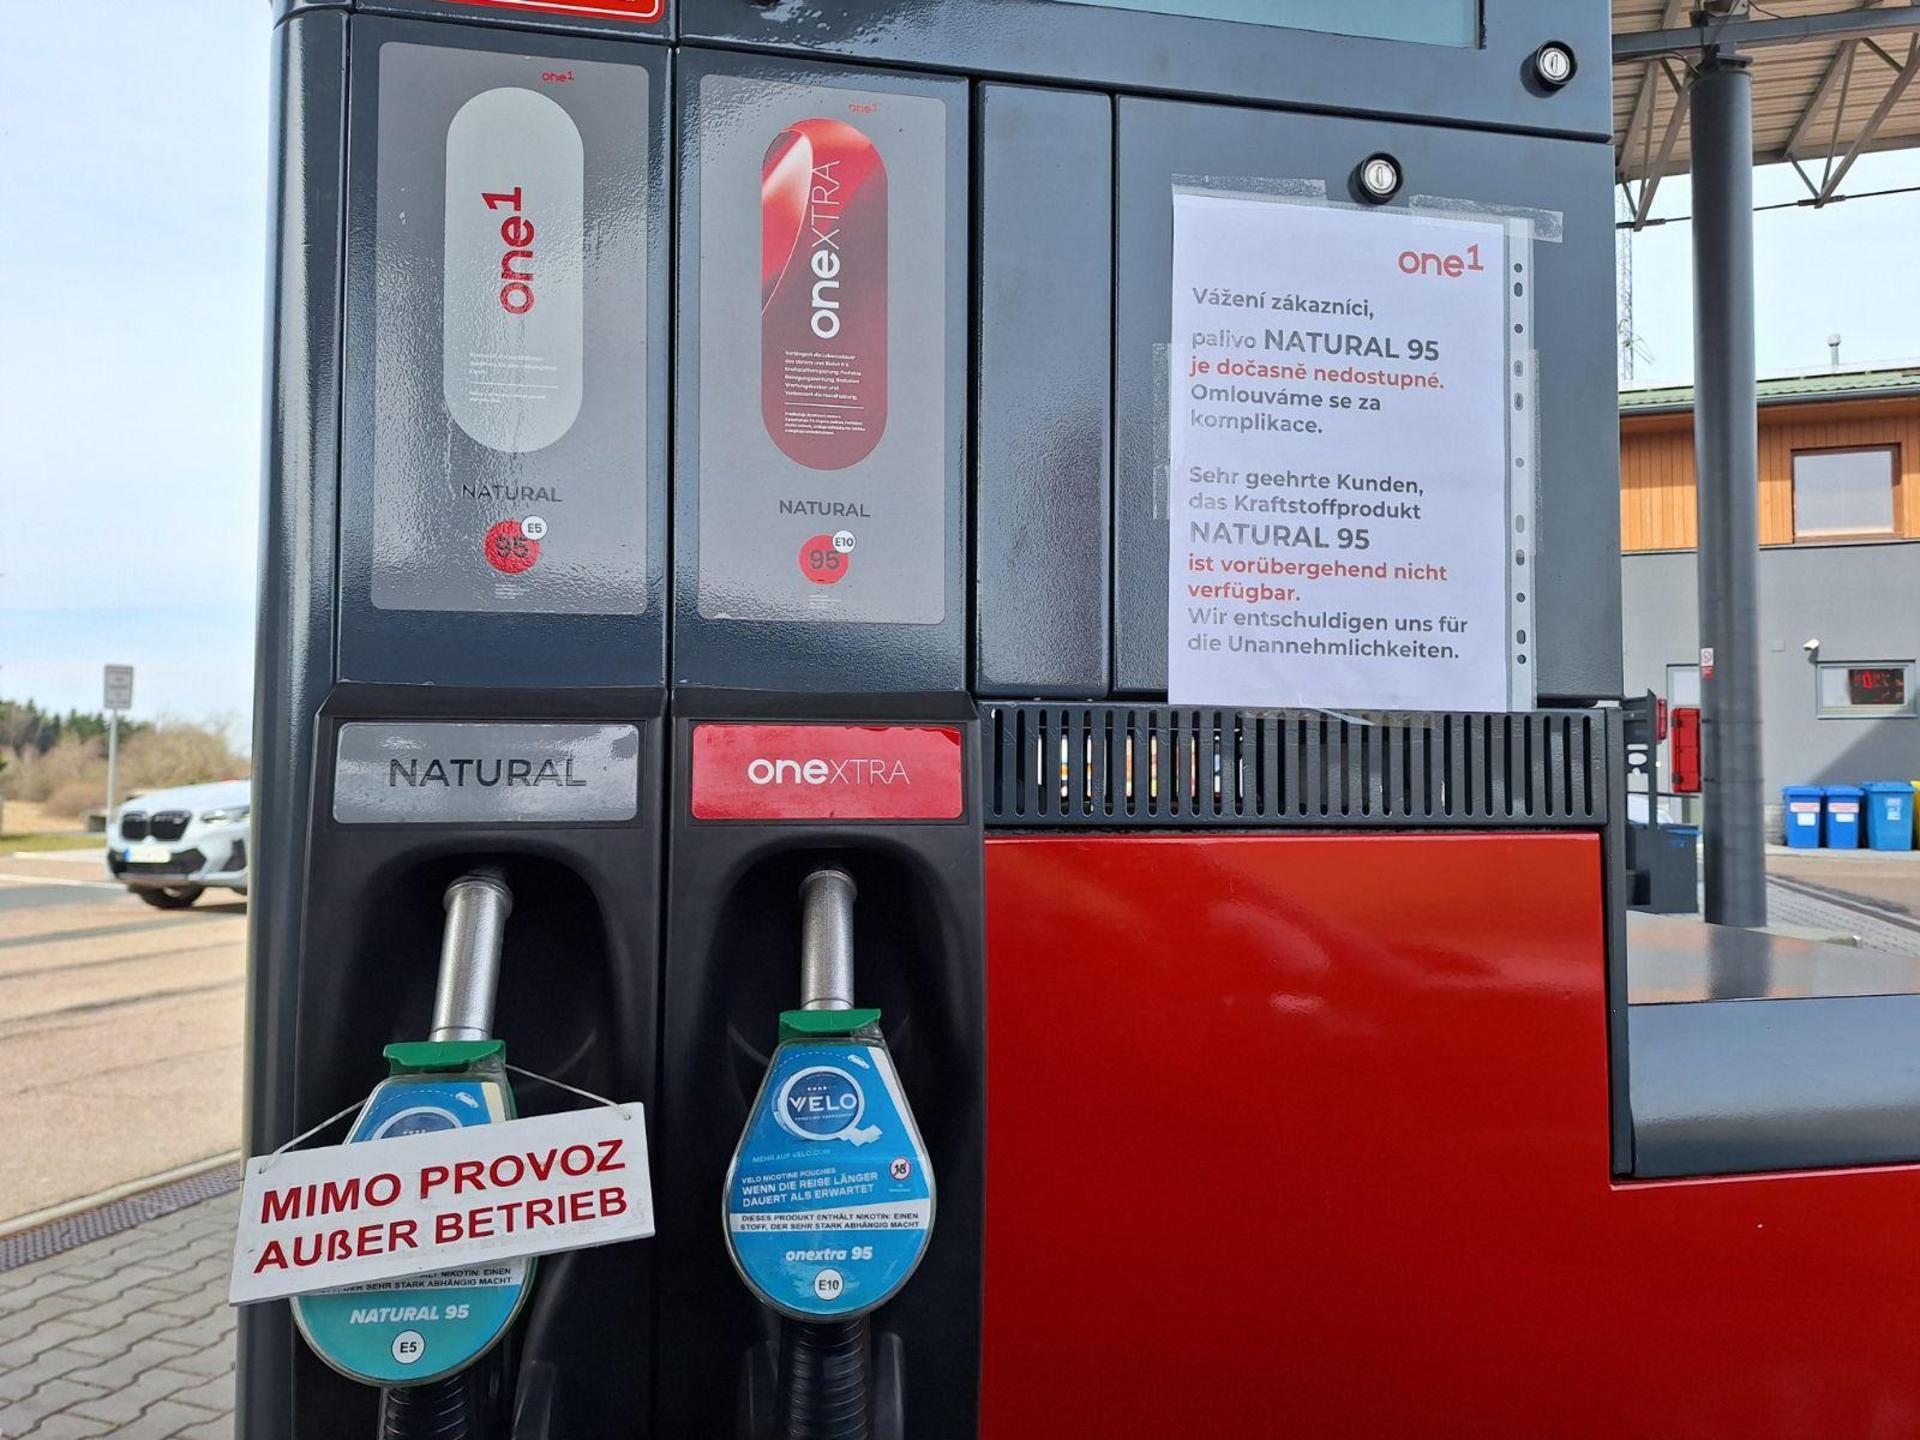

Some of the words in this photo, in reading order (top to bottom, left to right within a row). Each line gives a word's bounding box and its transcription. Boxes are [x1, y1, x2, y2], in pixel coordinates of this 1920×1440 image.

[481, 186, 535, 315] one1
[1398, 244, 1484, 277] one1
[1192, 287, 1266, 309] Vážení
[1272, 292, 1374, 319] zákazníci,
[1192, 329, 1257, 351] palivo
[1264, 329, 1400, 359] NATURAL
[1407, 339, 1439, 361] 95
[1189, 356, 1210, 378] je
[1217, 357, 1307, 380] dočasně
[1313, 363, 1444, 390] nedostupné.
[1191, 384, 1323, 408] Omlouváme
[1329, 394, 1352, 409] se
[1358, 396, 1381, 411] za
[1191, 409, 1322, 434] komplikace.
[462, 484, 562, 502] NATURAL
[1189, 467, 1239, 486] Sehr
[1246, 472, 1330, 491] geehrte
[1337, 474, 1424, 497] Kunden,
[779, 500, 871, 517] NATURAL
[1189, 493, 1228, 510] das
[1234, 494, 1421, 520] Kraftstoffprodukt
[527, 523, 542, 533] E5
[1190, 521, 1329, 548] NATURAL
[1337, 528, 1370, 550] 95
[495, 535, 529, 558] 95
[835, 537, 854, 547] E10
[810, 551, 840, 570] 95
[1189, 553, 1214, 572] ist
[1221, 556, 1387, 580] vorübergehend
[1394, 562, 1447, 581] nicht
[1188, 581, 1300, 603] verfügbar.
[1188, 607, 1227, 626] Wir
[1233, 612, 1388, 633] entschuldigen
[1395, 617, 1432, 632] uns
[1438, 615, 1468, 633] für
[1188, 633, 1221, 651] die
[1228, 635, 1459, 659] Unannehmlichkeiten.
[389, 759, 587, 788] NATURAL
[789, 1093, 857, 1112] VELO
[260, 1173, 401, 1224] MIMO
[420, 1139, 626, 1200] PROVOZ
[741, 1175, 761, 1184] VELO
[762, 1171, 798, 1182] NICOTINE
[742, 1183, 776, 1196] WENN
[778, 1181, 797, 1191] DIE
[800, 1177, 831, 1189] REISE
[833, 1172, 878, 1185] LÄNGER
[742, 1195, 788, 1208] DAUERT
[790, 1191, 812, 1202] ALS
[814, 1184, 875, 1199] ERWARTET
[742, 1214, 772, 1222] DIESES
[773, 1213, 814, 1221] PRODUKT
[816, 1212, 852, 1220] ENTHÄLT
[894, 1212, 919, 1220] EINEN
[770, 1222, 788, 1230] DER
[790, 1222, 813, 1230] SEHR
[815, 1221, 842, 1229] STARK
[844, 1220, 888, 1229] ABHÄNGIG
[890, 1221, 919, 1229] MACHT
[253, 1219, 419, 1274] AUßER
[435, 1186, 628, 1244] BETRIEB
[785, 1246, 847, 1261] onextra
[851, 1246, 873, 1261] 95
[366, 1282, 392, 1290] SEHR
[394, 1280, 425, 1289] STARK
[427, 1277, 476, 1287] ABHÄNGIG
[479, 1276, 512, 1285] MACHT
[483, 1267, 511, 1276] EINEN
[818, 1279, 840, 1291] E10
[350, 1306, 439, 1324] NATURAL
[445, 1304, 470, 1319] 95
[400, 1342, 417, 1353] E5
